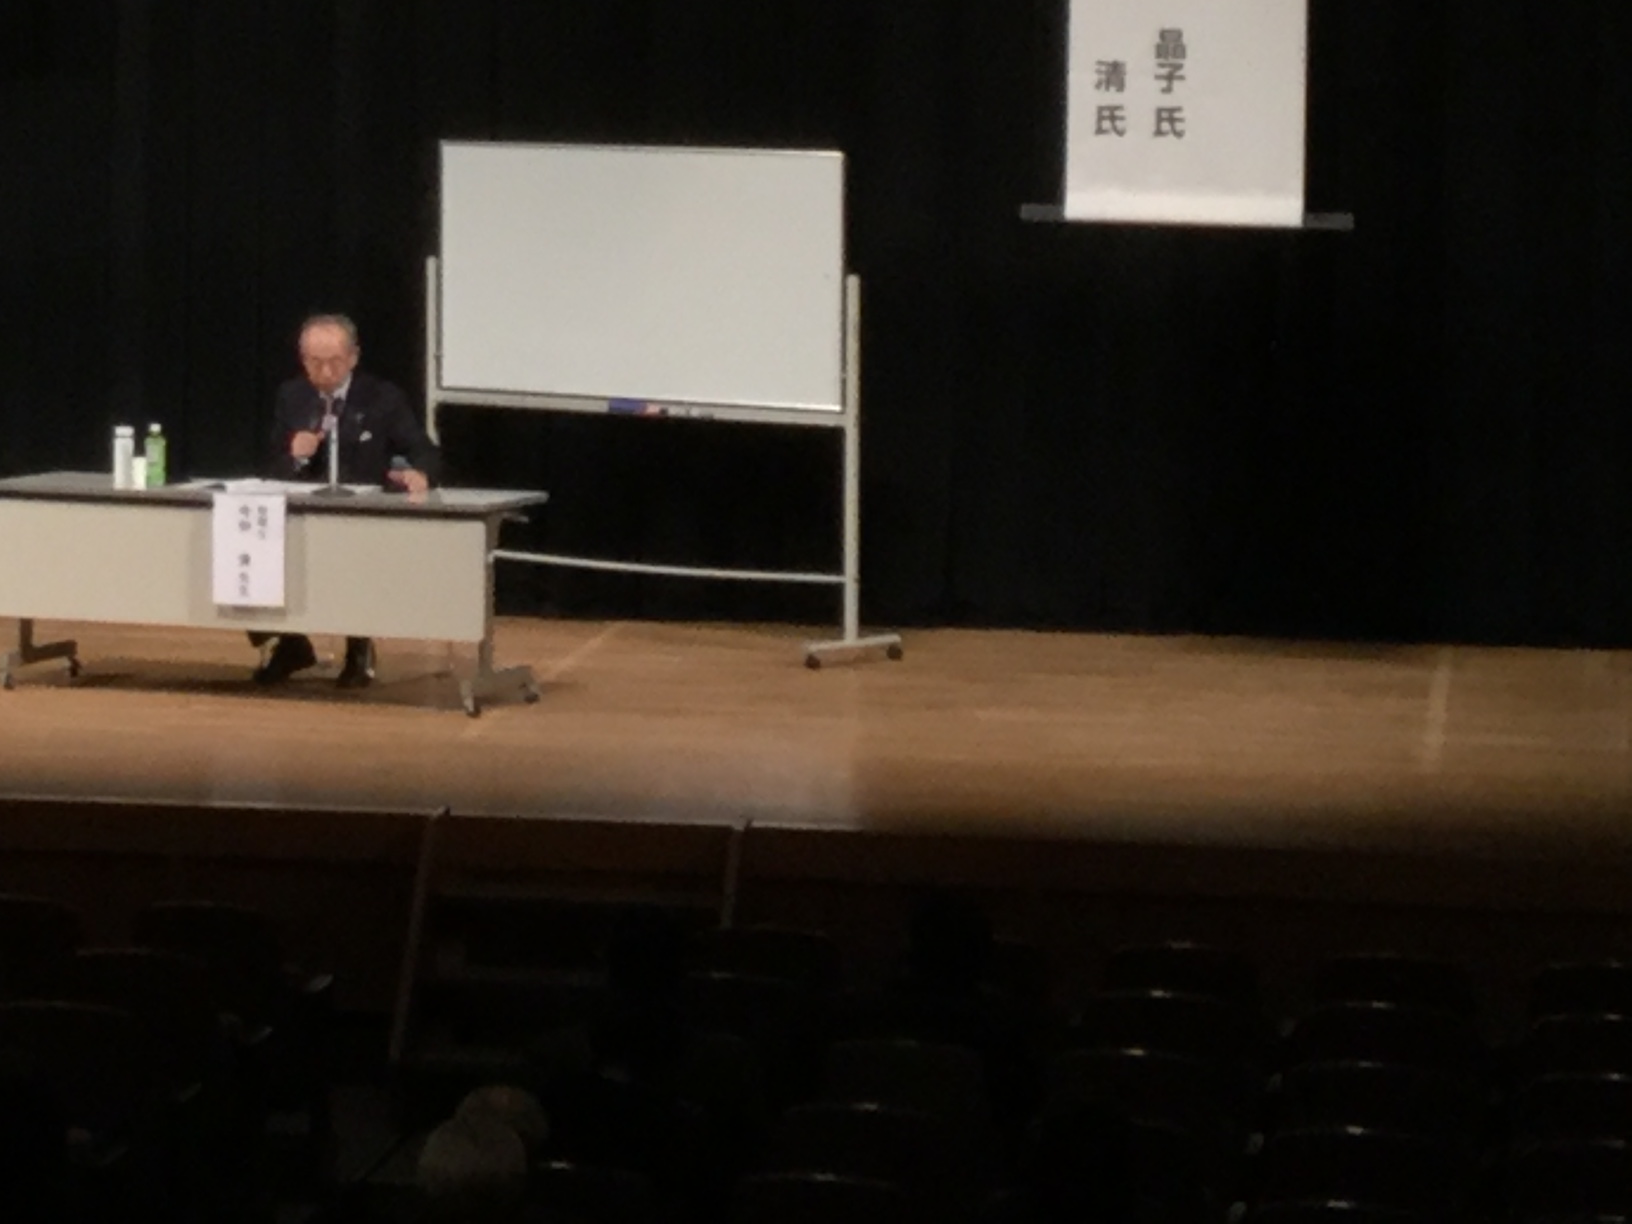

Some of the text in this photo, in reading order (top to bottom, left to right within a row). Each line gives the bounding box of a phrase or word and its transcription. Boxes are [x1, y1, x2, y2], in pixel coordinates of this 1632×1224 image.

[1094, 59, 1127, 93] 清
[1153, 28, 1187, 95] 晶子
[1094, 104, 1127, 138] 氏
[1152, 105, 1186, 140] 氏
